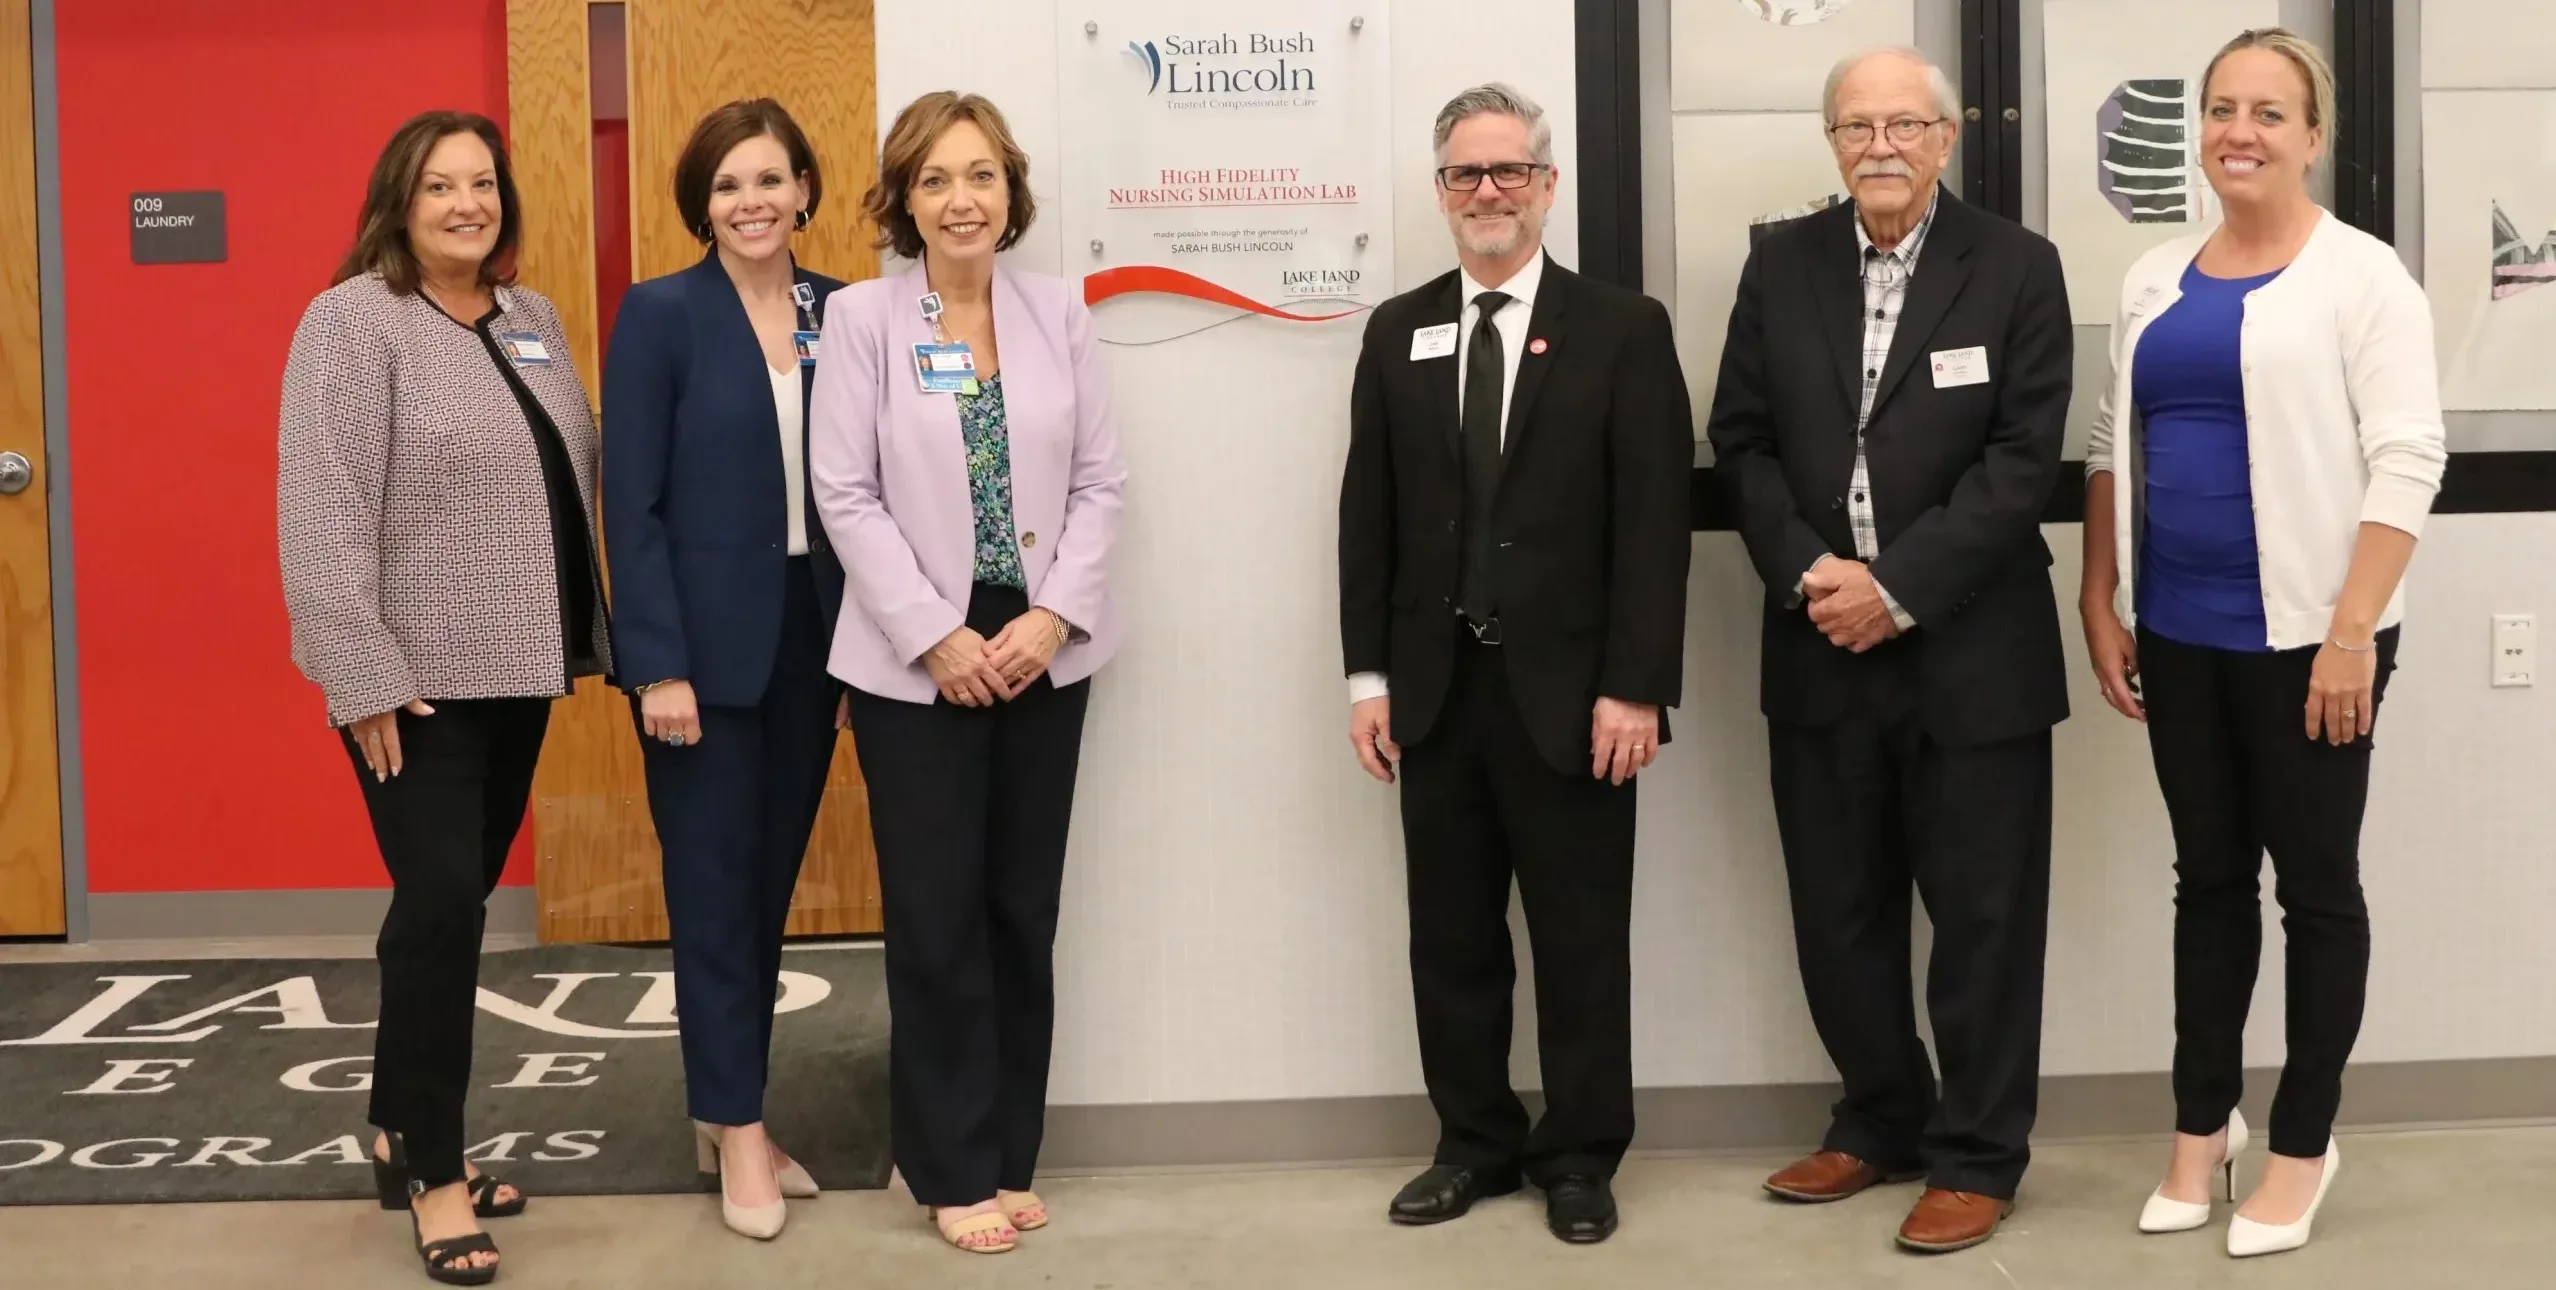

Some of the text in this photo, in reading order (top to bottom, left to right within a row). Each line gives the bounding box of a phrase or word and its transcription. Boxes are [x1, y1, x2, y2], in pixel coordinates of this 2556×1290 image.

[1165, 32, 1314, 55] Sarah Bush
[1168, 58, 1315, 93] Lincoln
[1167, 97, 1318, 111] Trusted Compassionate Care
[1160, 168, 1299, 184] HIGH FIDELITY
[1109, 184, 1356, 203] NURSING SIMULATION LAB
[134, 198, 162, 212] 009
[135, 215, 194, 228] LAUNDRY
[1153, 230, 1175, 238] made
[1177, 229, 1209, 239] possible
[1211, 229, 1241, 238] through
[1258, 229, 1297, 238] generosity
[1171, 242, 1293, 253] SARAH BUSH LINCOLN
[1283, 269, 1360, 285] LAKE LAND
[1291, 285, 1353, 293] COLLEGE
